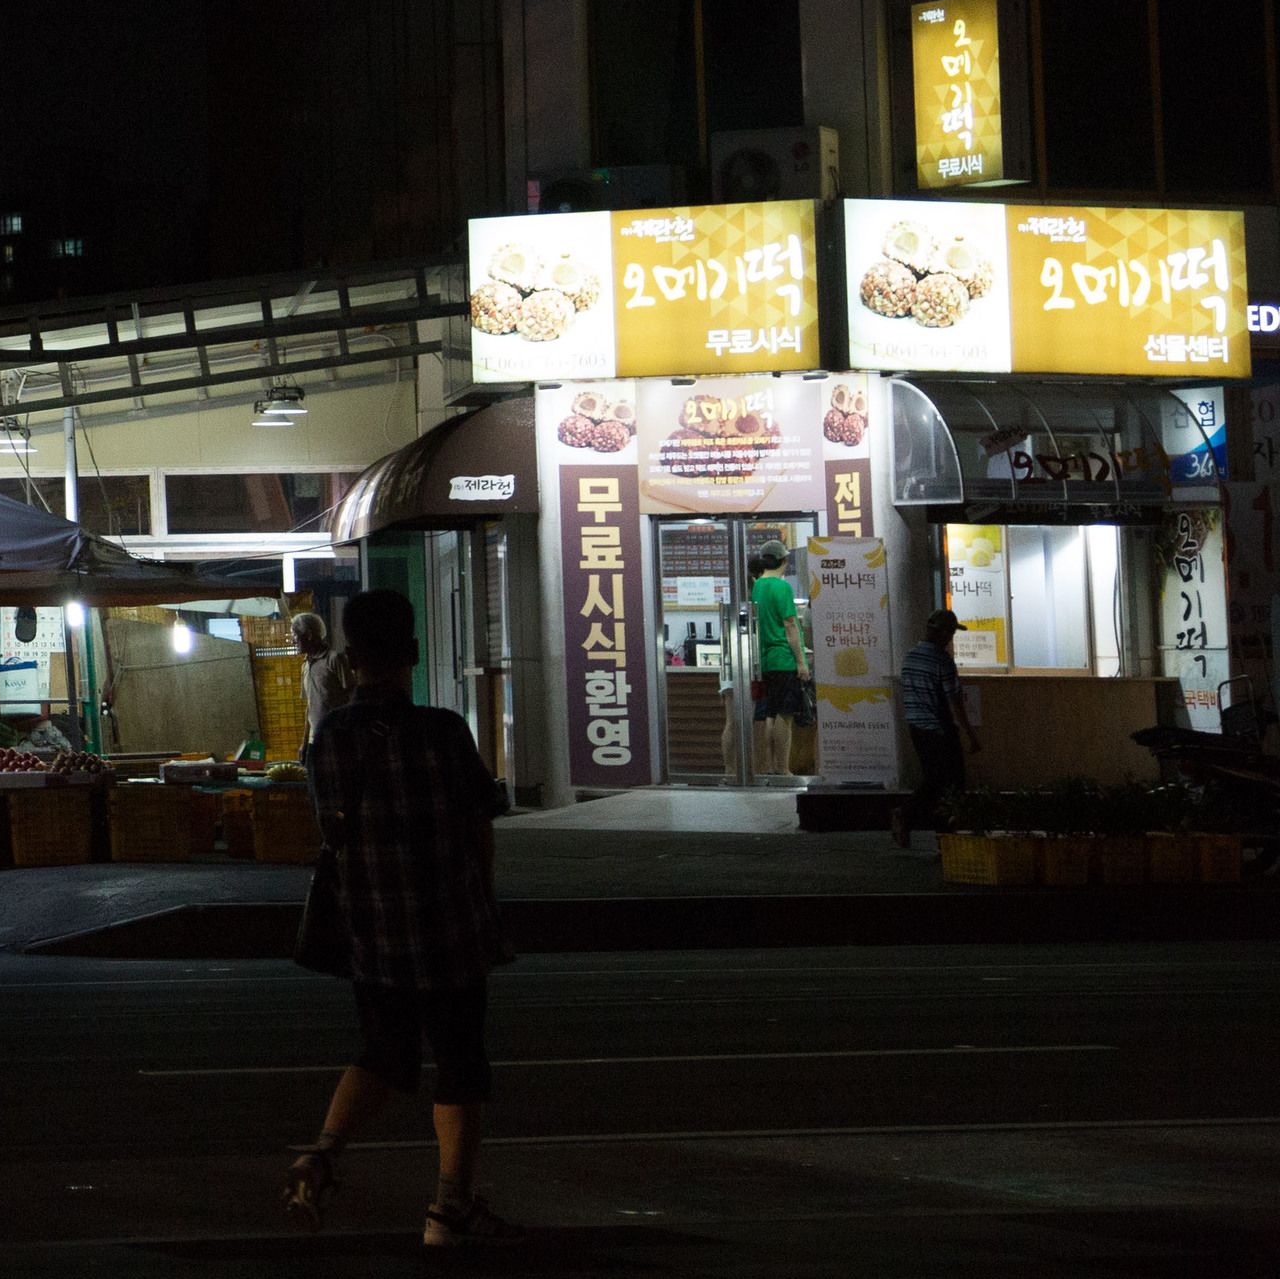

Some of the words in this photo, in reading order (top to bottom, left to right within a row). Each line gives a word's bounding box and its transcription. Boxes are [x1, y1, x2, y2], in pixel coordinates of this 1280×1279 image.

[941, 19, 974, 151] 오메기떡
[938, 154, 983, 179] 무료시식
[623, 233, 804, 317] 오메기떡
[1040, 238, 1230, 333] 오메기떡
[705, 326, 801, 356] 무료시식
[1144, 335, 1230, 364] 선물센터
[685, 388, 775, 429] 오메기떡
[822, 572, 876, 589] 바나나떡
[1174, 512, 1208, 678] 오메기떡
[825, 635, 836, 647] 안
[840, 635, 878, 647] 바나나?
[832, 623, 870, 634] 바나나?
